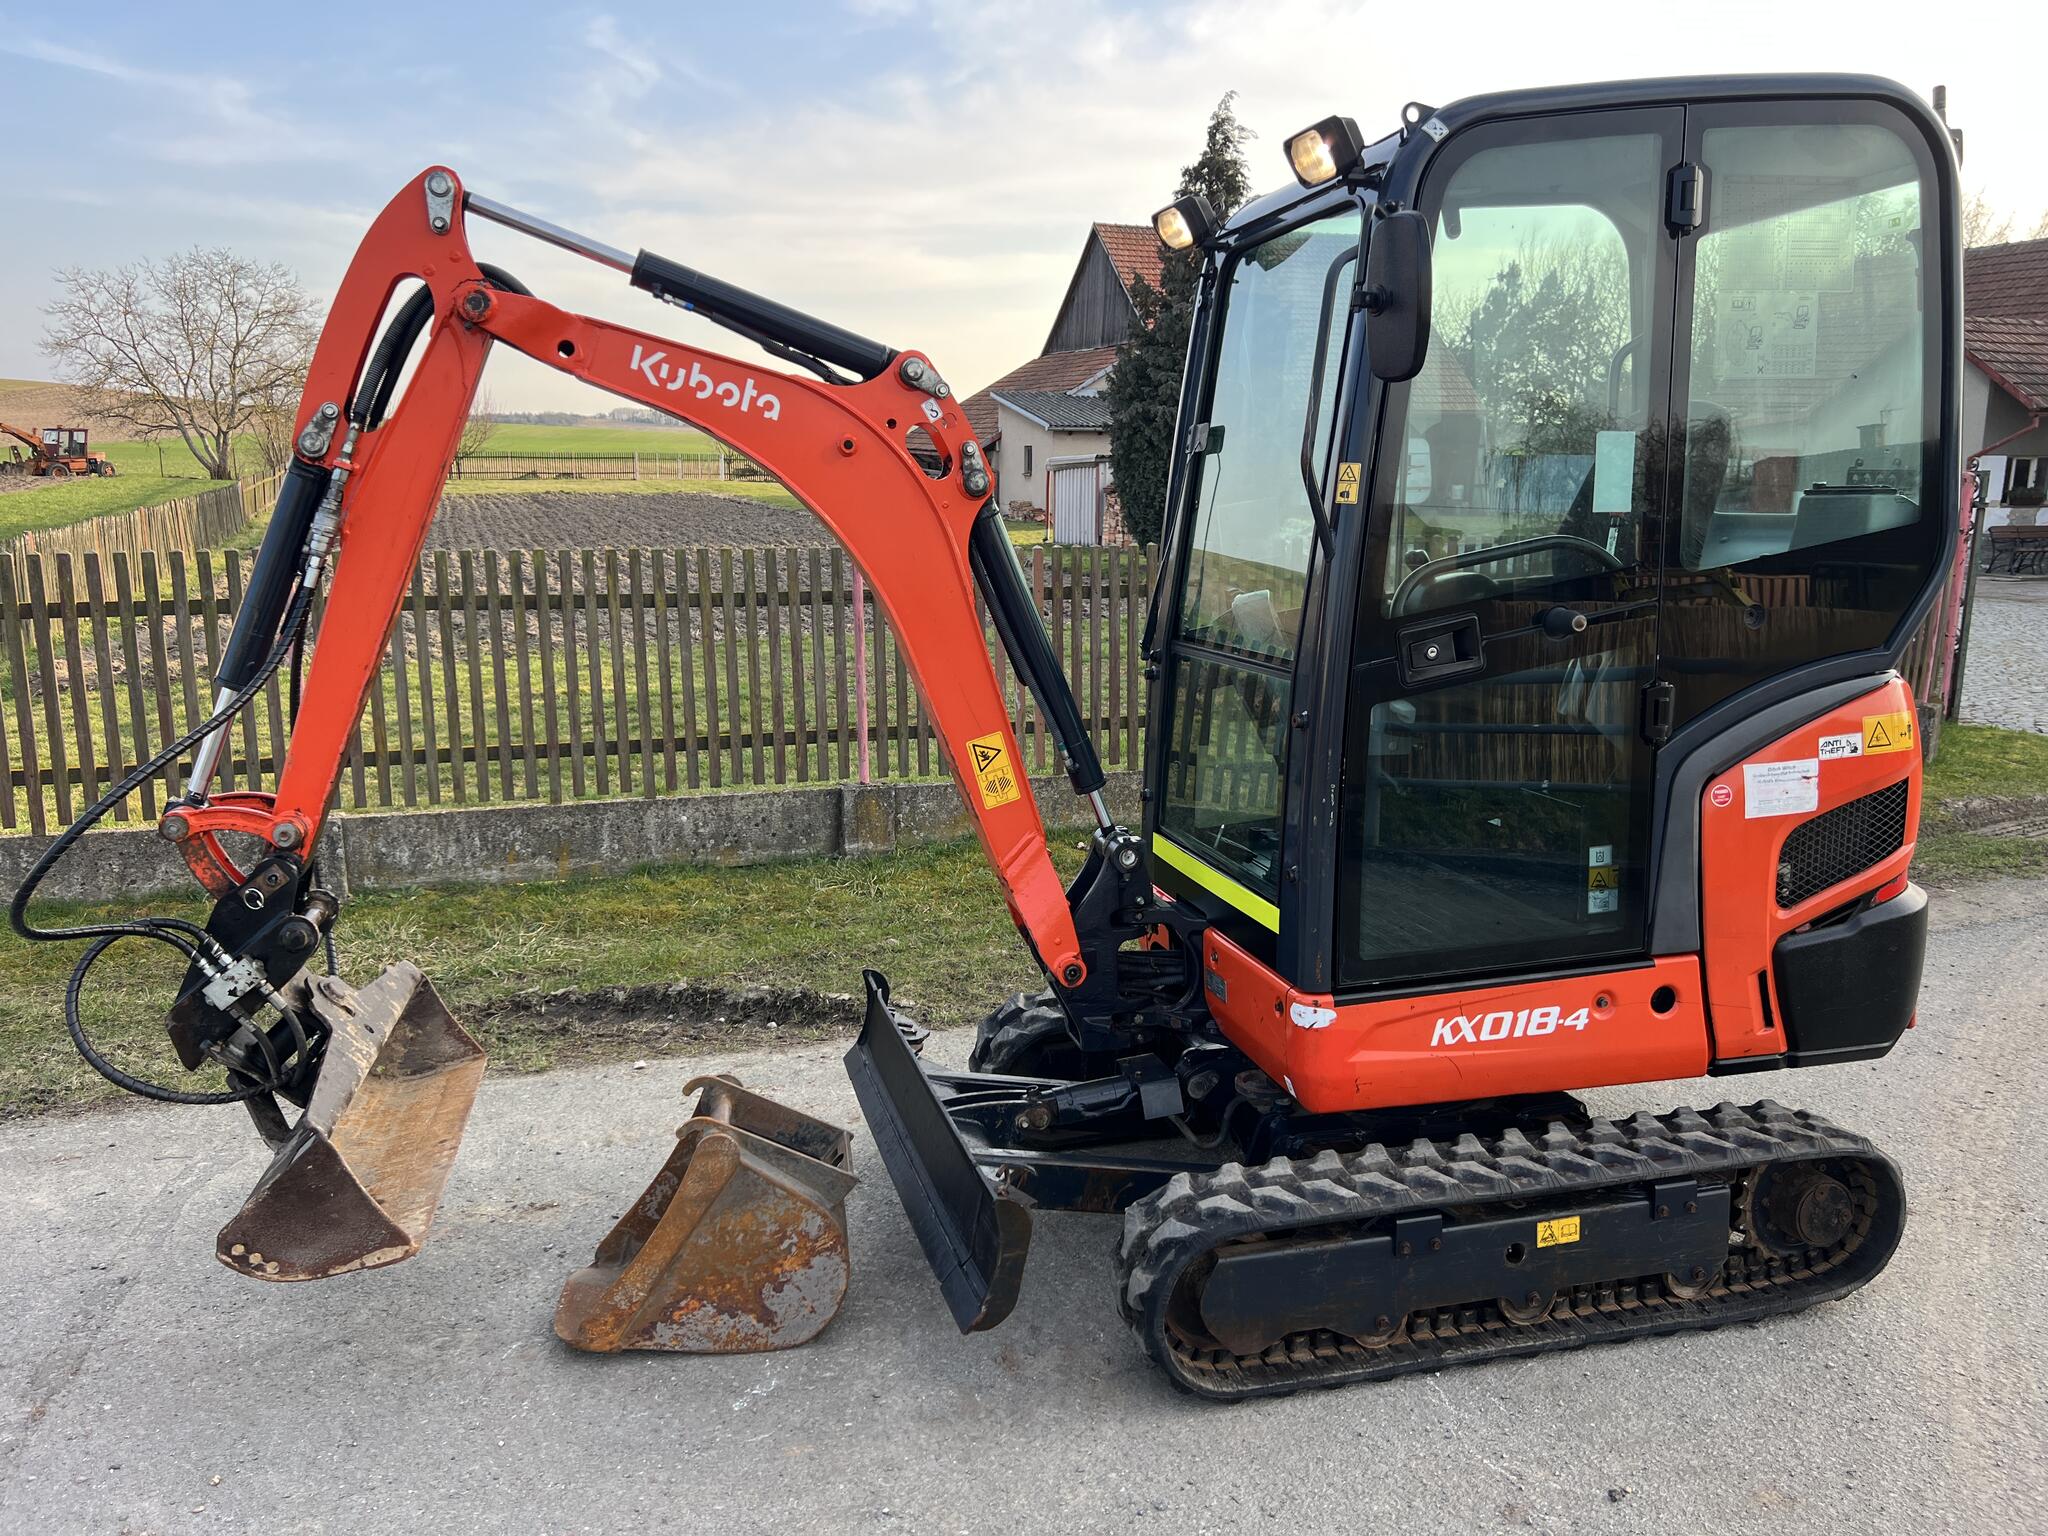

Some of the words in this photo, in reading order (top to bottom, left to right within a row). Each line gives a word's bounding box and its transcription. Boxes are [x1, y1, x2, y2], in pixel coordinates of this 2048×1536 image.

[630, 344, 781, 421] Kubota
[1820, 739, 1842, 749] ANTI
[1820, 746, 1846, 755] THEFT
[1430, 1005, 1589, 1047] KX018-4
